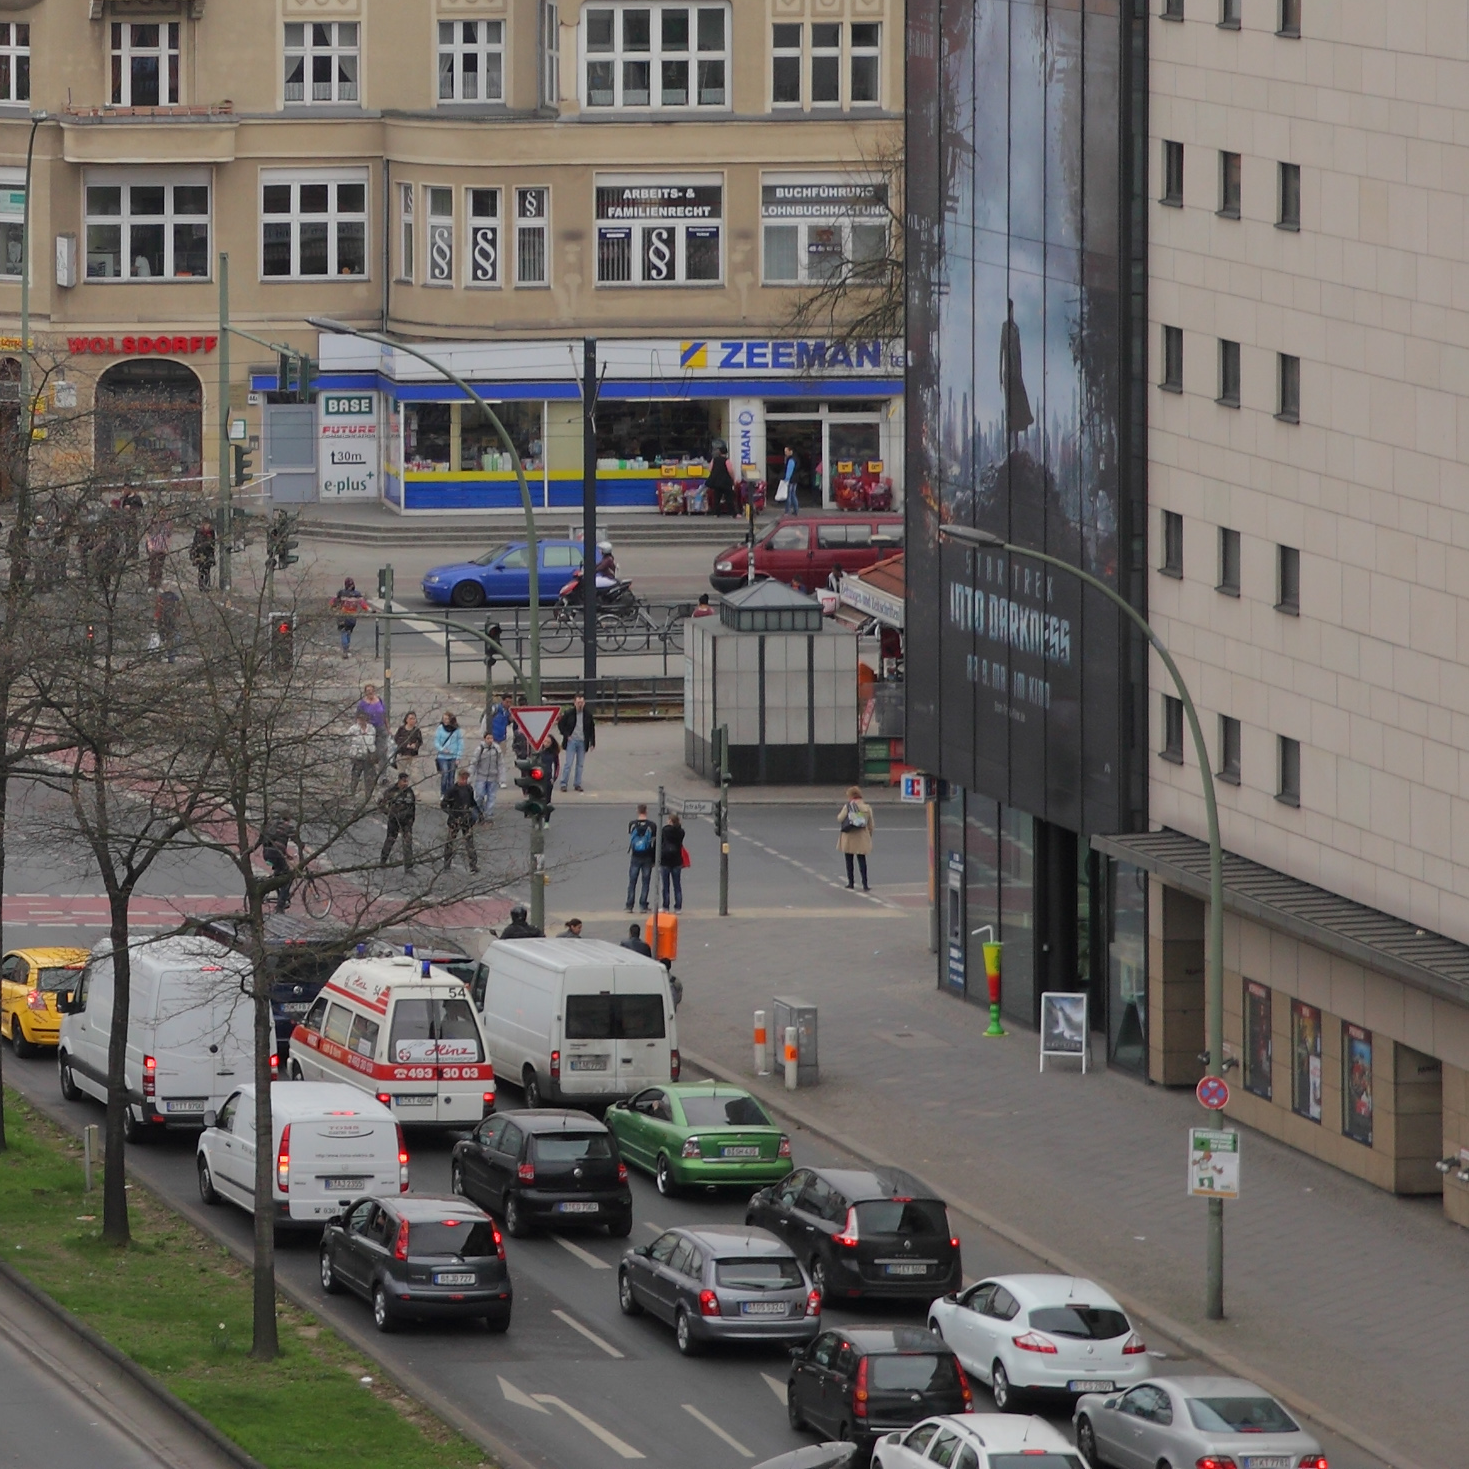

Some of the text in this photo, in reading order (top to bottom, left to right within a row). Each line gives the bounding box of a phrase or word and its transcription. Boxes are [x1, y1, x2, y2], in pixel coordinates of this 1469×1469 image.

[623, 188, 682, 199] ARBEITS-
[608, 206, 711, 218] FAMILIENRECHT
[67, 336, 218, 354] WOLSDORFF
[718, 341, 881, 369] ZEEMAN
[328, 399, 370, 413] BASE
[322, 425, 376, 434] FUTURE
[337, 451, 362, 461] 30m
[965, 550, 1053, 603] STAR TREK
[950, 582, 1071, 666] INTO DARKNESS
[448, 987, 466, 998] 54
[425, 1043, 476, 1057] Hinz
[408, 1067, 479, 1078] 493 30 03
